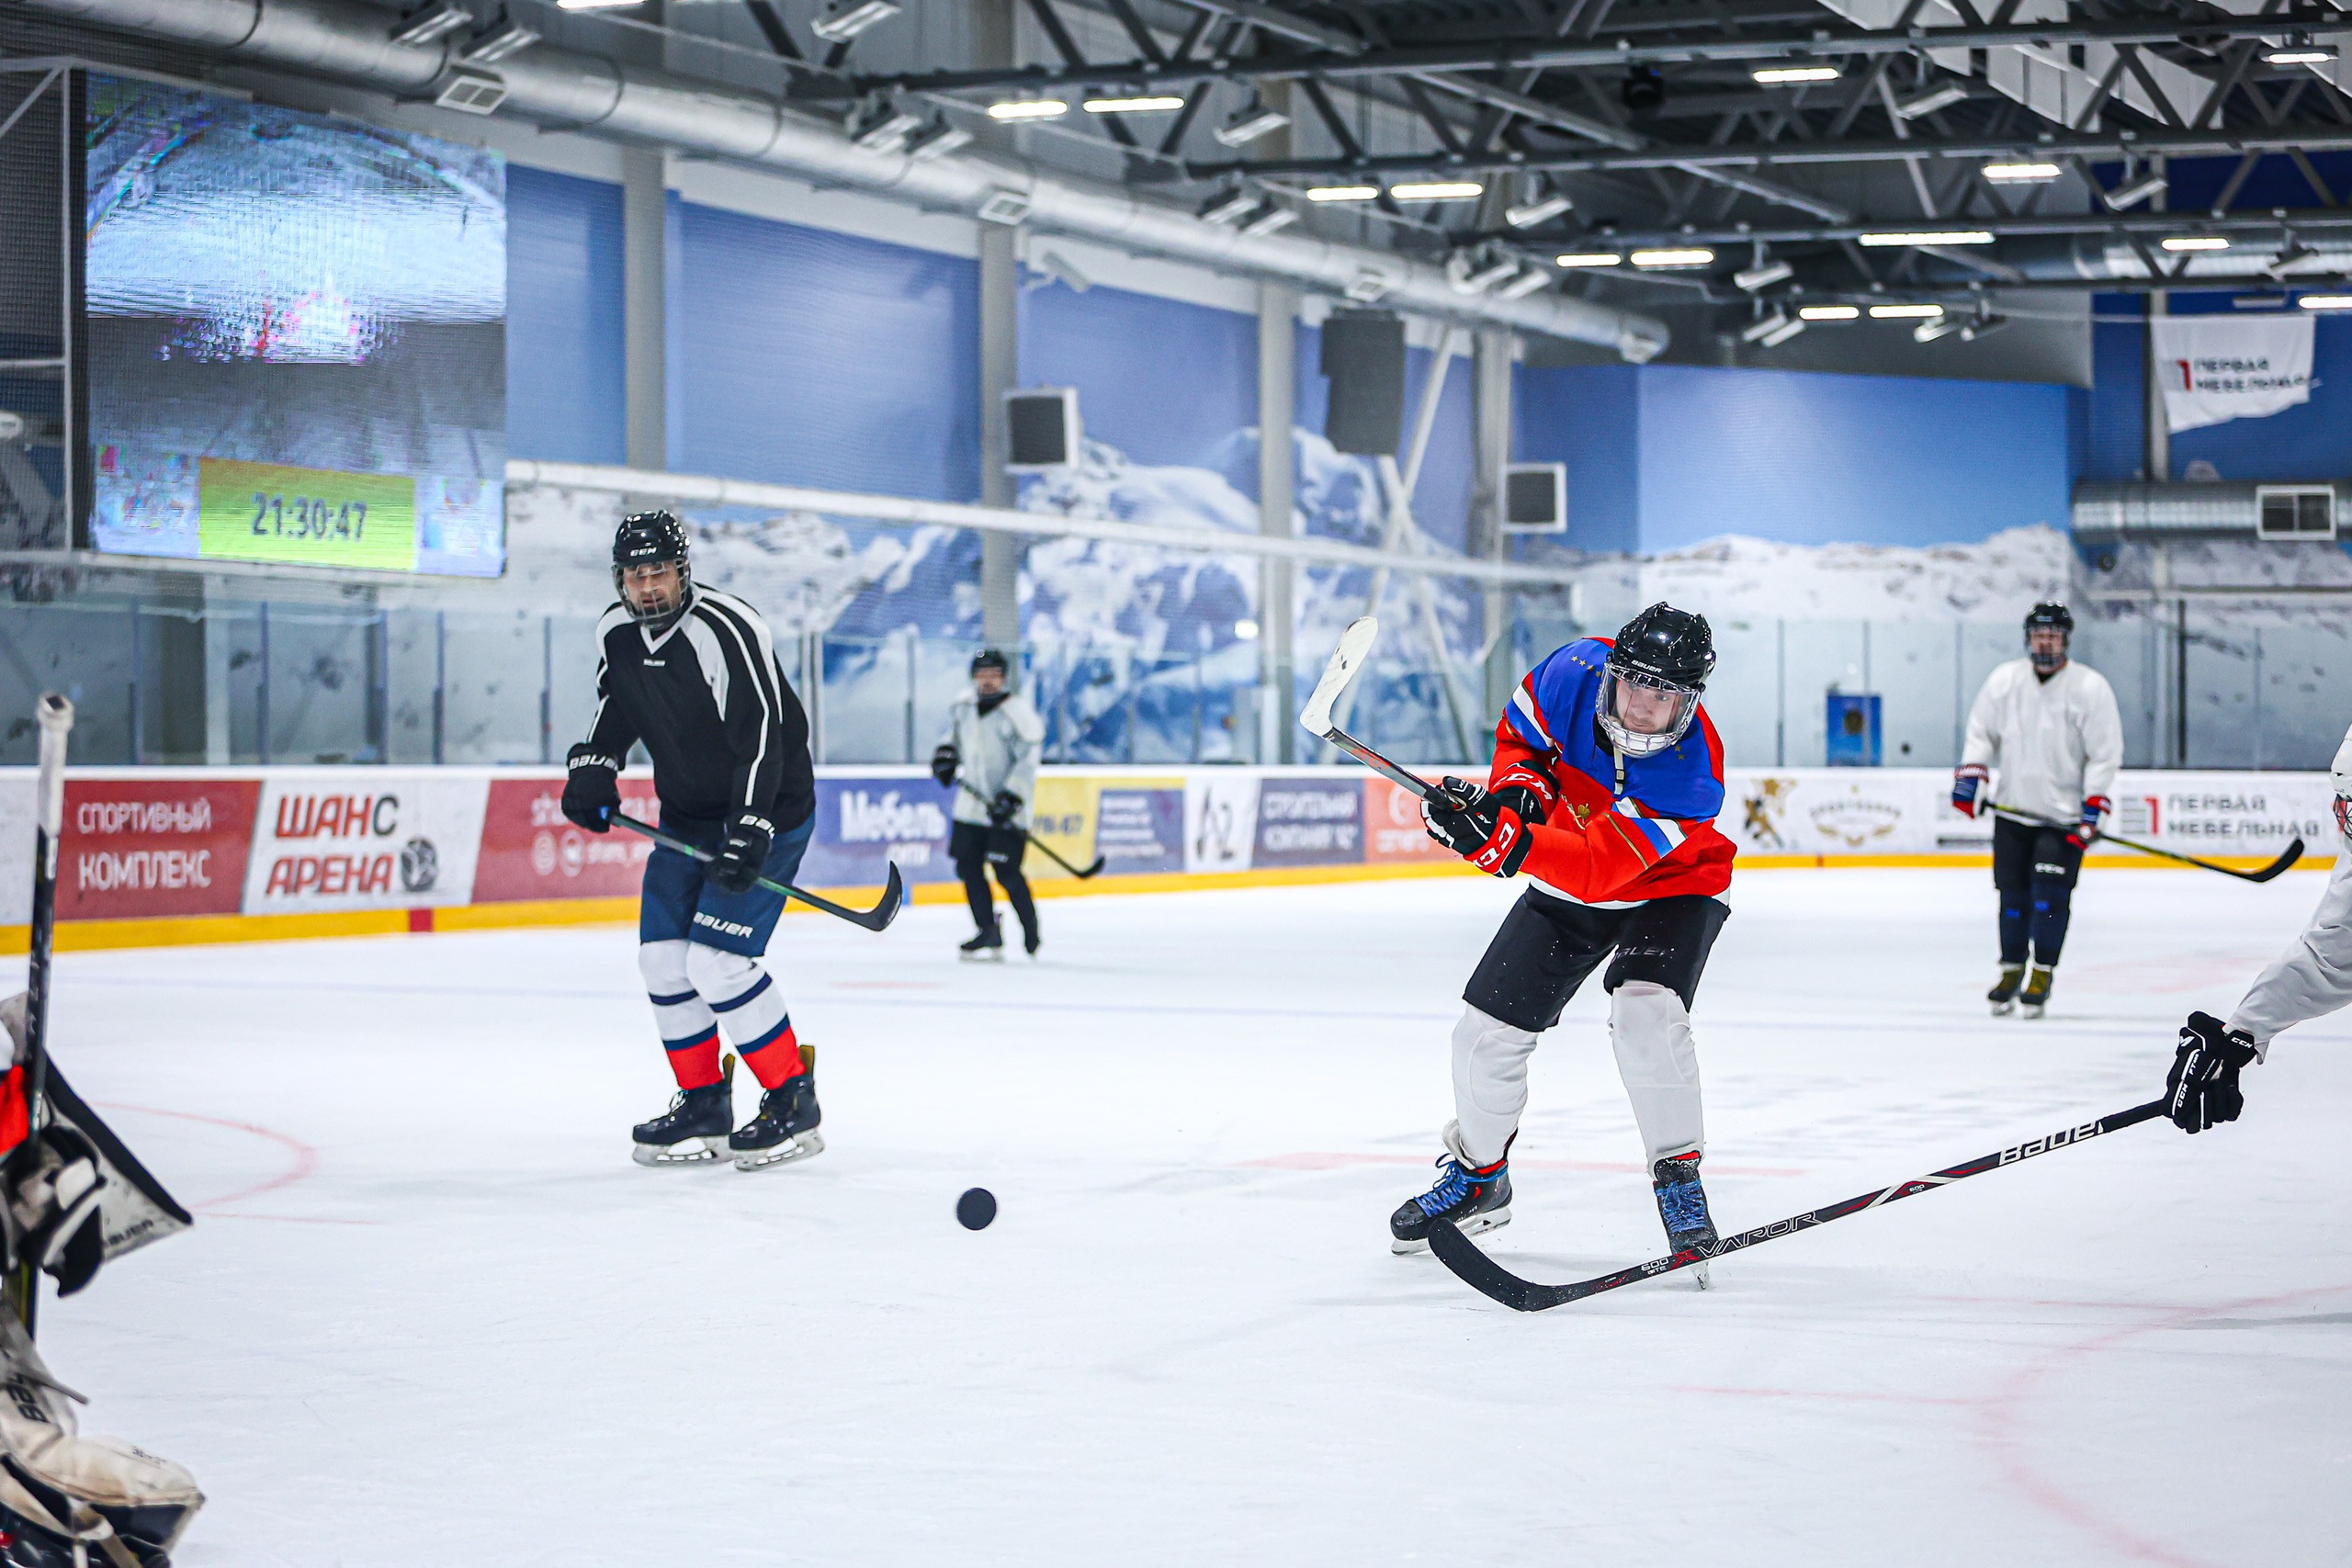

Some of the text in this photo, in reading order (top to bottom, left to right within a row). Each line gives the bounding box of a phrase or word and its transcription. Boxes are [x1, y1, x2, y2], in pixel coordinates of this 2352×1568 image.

[252, 491, 368, 541] 21:30:47
[1631, 659, 1663, 673] BAUER
[76, 798, 212, 833] СПОРТИВНЫЙ
[274, 793, 400, 840] ШАНС
[2168, 794, 2267, 812] ПЕРВАЯ
[77, 849, 212, 892] КОМПЛЕКС
[265, 853, 395, 897] АРЕНА
[693, 911, 753, 938] BAUER
[2231, 1036, 2253, 1049] CCM
[2177, 1083, 2188, 1108] CCM
[1998, 1120, 2104, 1167] BAUE
[1696, 1211, 1824, 1258] VAPOR
[1641, 1258, 1669, 1271] 600
